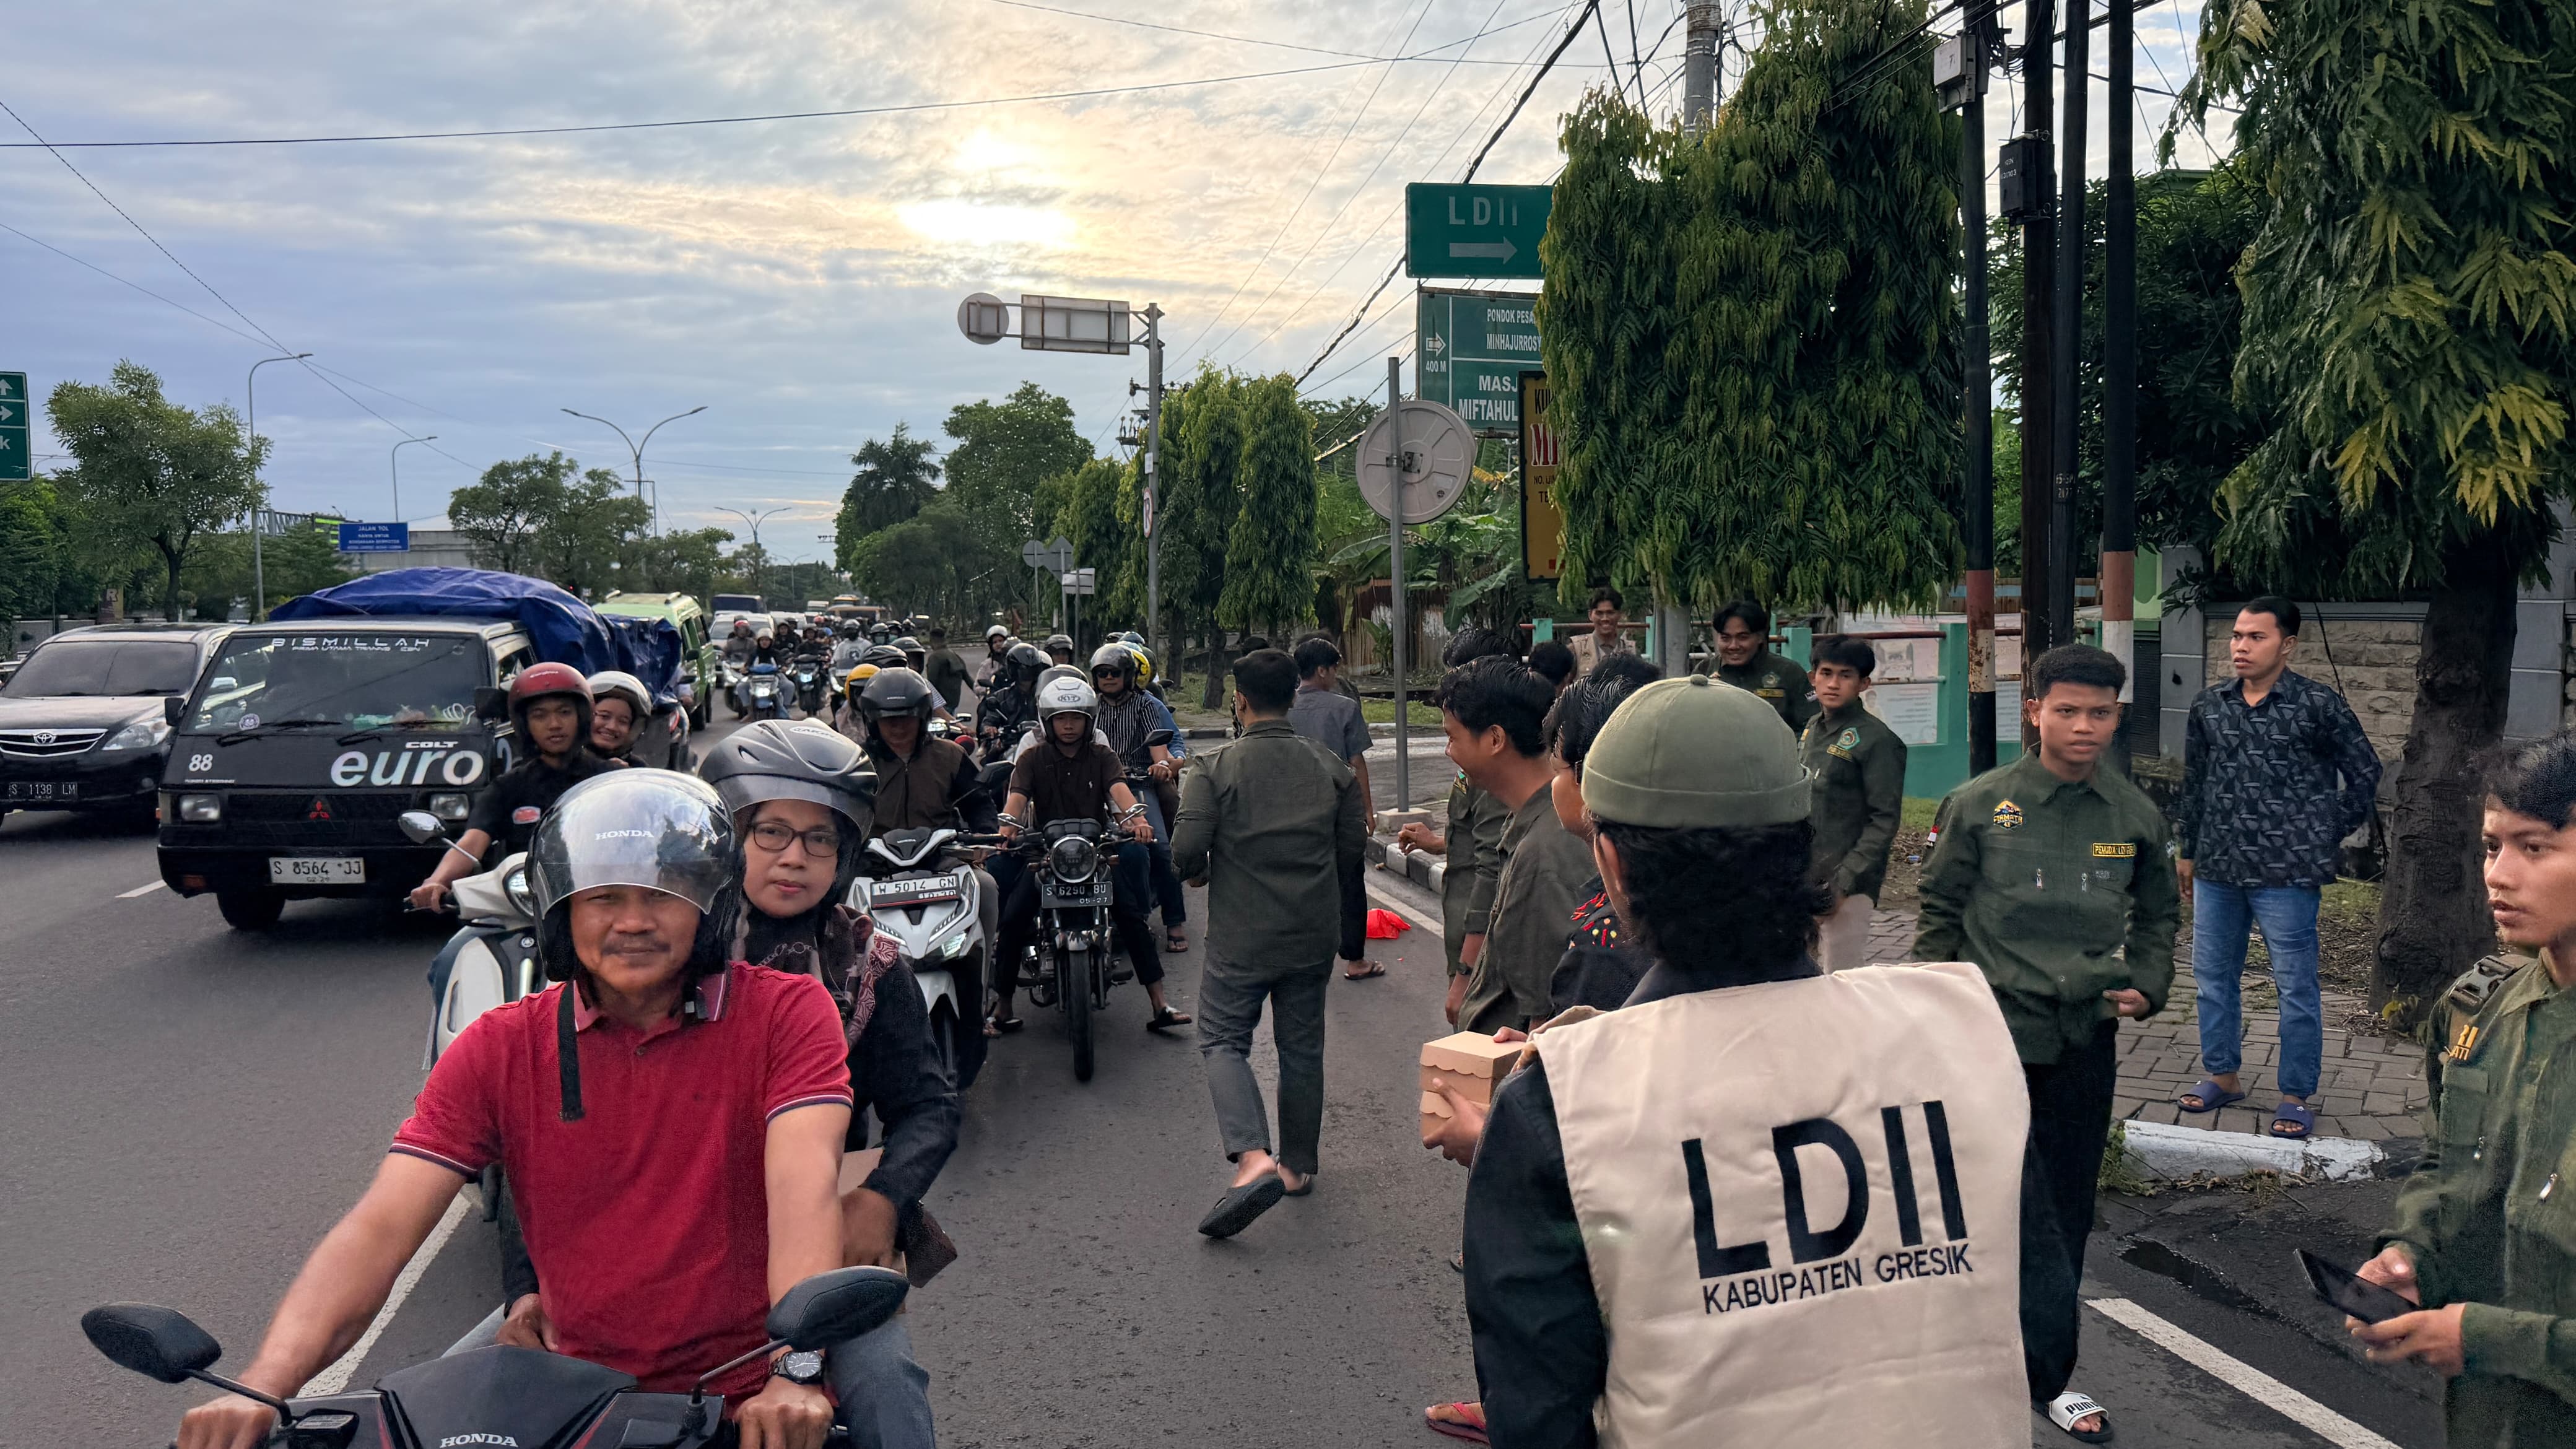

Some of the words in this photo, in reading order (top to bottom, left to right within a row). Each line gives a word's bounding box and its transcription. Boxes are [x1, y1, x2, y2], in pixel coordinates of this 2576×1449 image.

[1448, 196, 1518, 226] LDII
[1487, 308, 1515, 324] PONDOK
[1516, 309, 1538, 324] PESA
[1425, 360, 1438, 373] 400
[1440, 360, 1447, 372] M
[1458, 398, 1518, 422] MIFTAHUL
[271, 637, 430, 647] BISMILLAH
[188, 754, 213, 772] 88
[331, 750, 484, 788] euro
[12, 784, 17, 794] S
[30, 784, 52, 794] 1138
[63, 784, 75, 794] LM
[594, 830, 655, 840] HONDA
[274, 861, 282, 874] S
[293, 861, 329, 875] 8564
[344, 861, 361, 874] JJ
[879, 885, 887, 894] W
[895, 881, 926, 893] 5014
[939, 877, 954, 887] GN
[1046, 887, 1053, 896] S
[1094, 884, 1106, 894] BU
[1681, 1100, 1968, 1280] LDII
[1702, 1258, 1863, 1315] KABUPATEN
[1875, 1243, 1973, 1283] GRESIK
[439, 1433, 519, 1448] HONDA
